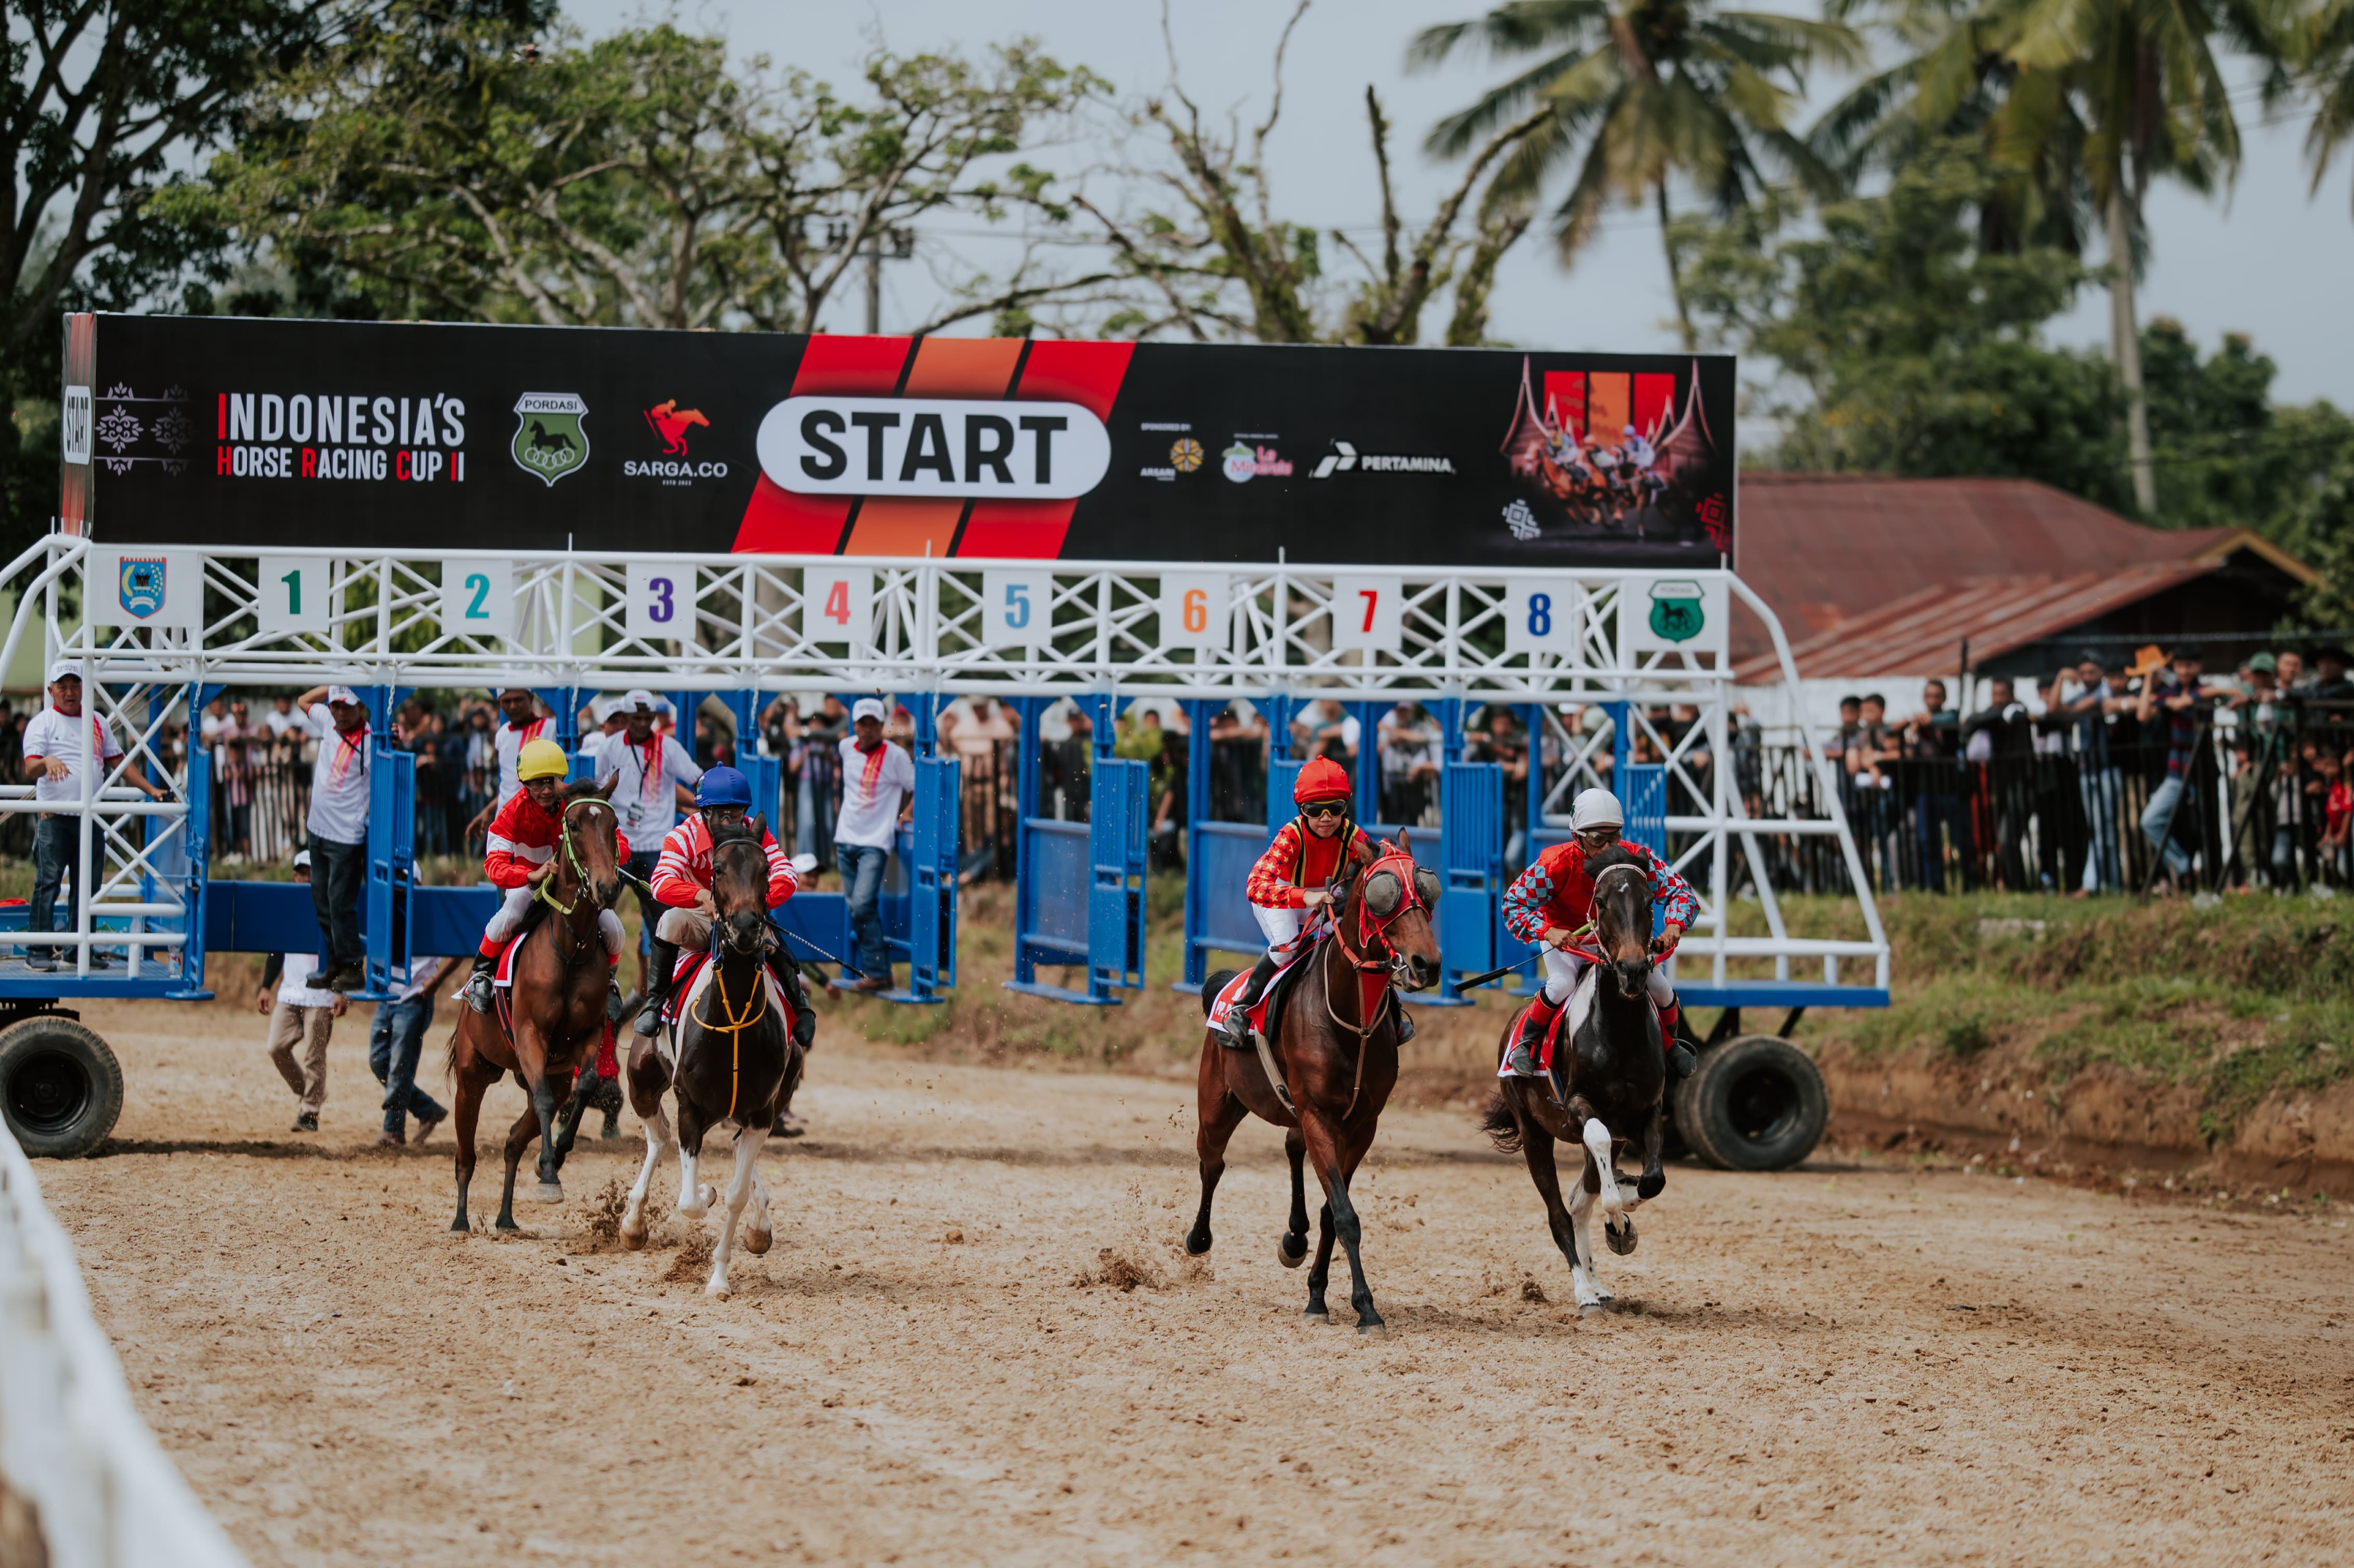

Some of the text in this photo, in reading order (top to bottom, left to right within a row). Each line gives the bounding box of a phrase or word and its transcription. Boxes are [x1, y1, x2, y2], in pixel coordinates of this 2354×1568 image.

[67, 395, 88, 454] START
[218, 393, 465, 447] INDONESIA'S
[525, 400, 577, 410] PORDASI
[217, 446, 464, 482] HORSE RACING CUP II
[800, 410, 1067, 484] START
[1362, 455, 1452, 473] PERTAMINA
[624, 461, 728, 478] SARGA.CO
[281, 570, 300, 615] 1
[465, 573, 490, 619] 2
[649, 578, 674, 622] 3
[825, 581, 851, 625] 4
[1005, 584, 1030, 629] 5
[1183, 589, 1207, 633] 6
[1358, 590, 1378, 633] 7
[1527, 593, 1551, 637] 8
